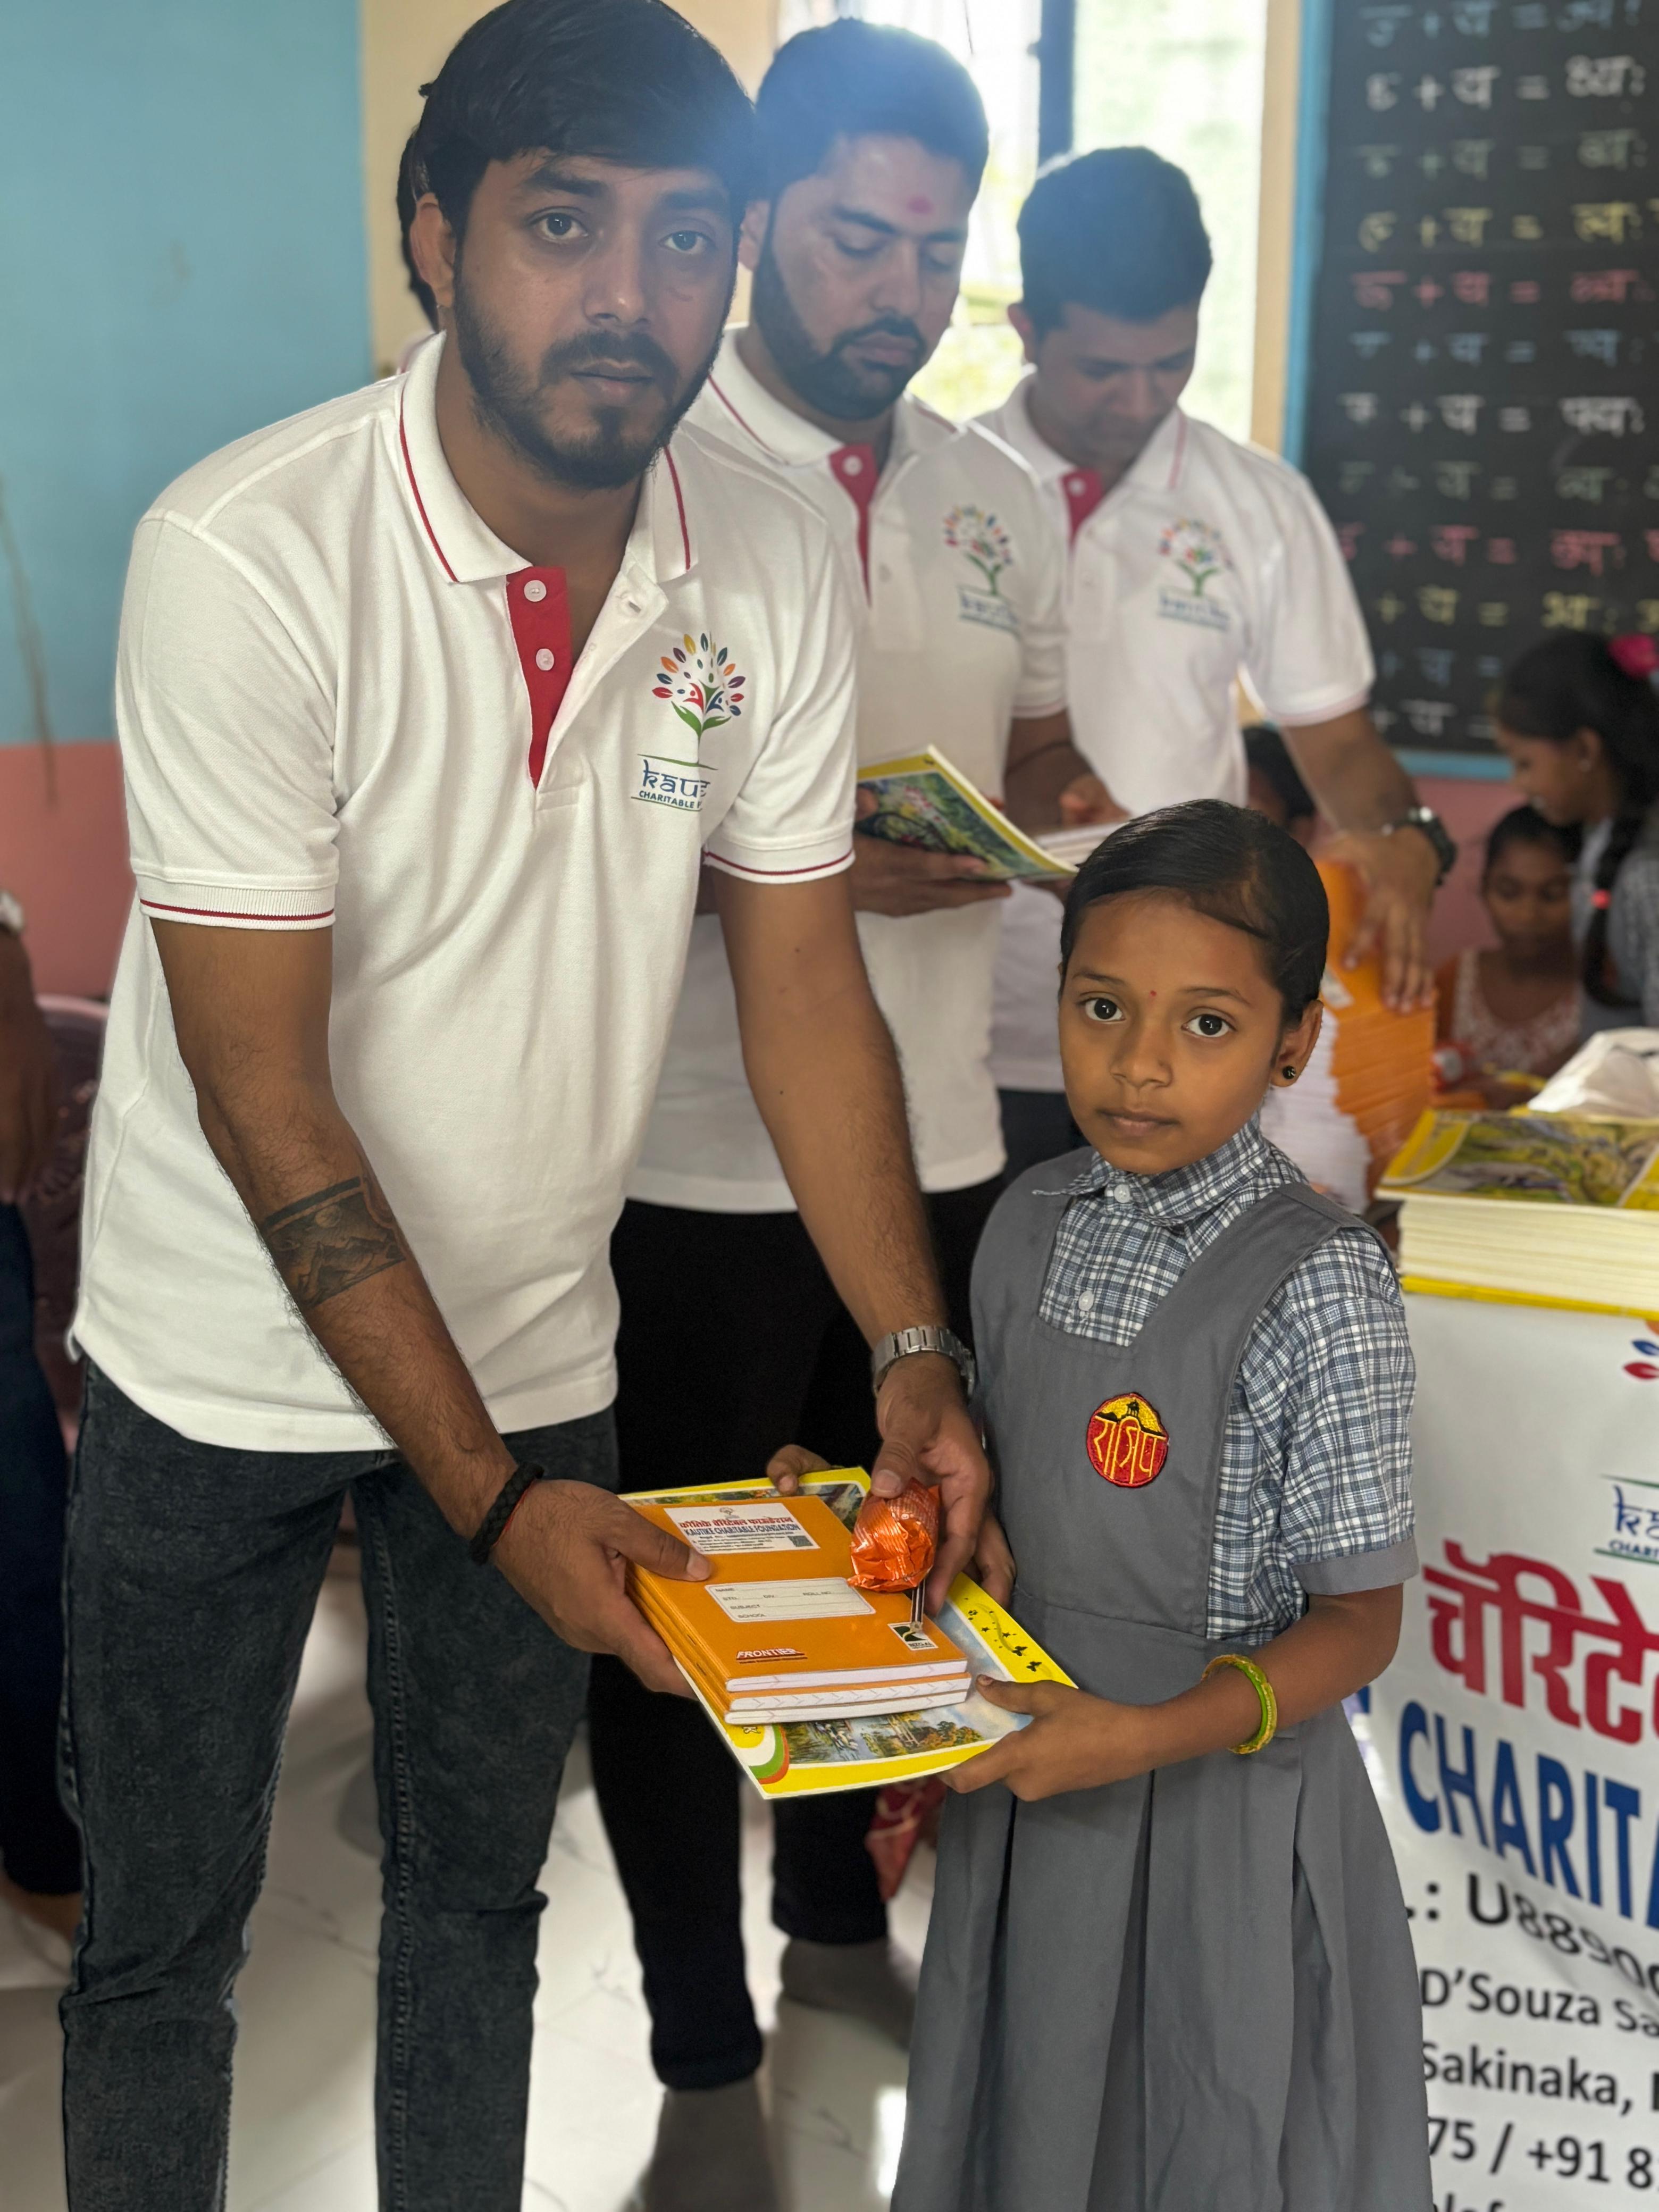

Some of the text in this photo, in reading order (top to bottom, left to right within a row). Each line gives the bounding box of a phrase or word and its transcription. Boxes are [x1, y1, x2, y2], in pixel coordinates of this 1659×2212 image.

[639, 790, 694, 809] CHARITABLE
[684, 1527, 715, 1536] KAUTIKE
[716, 1525, 754, 1535] CHARITABLE
[755, 1523, 800, 1533] FOUNDATION
[736, 1648, 797, 1659] FRONTIER
[1423, 2040, 1633, 2117] Sakinaka,
[1527, 2135, 1610, 2184] +91
[1626, 2147, 1659, 2190] 8
